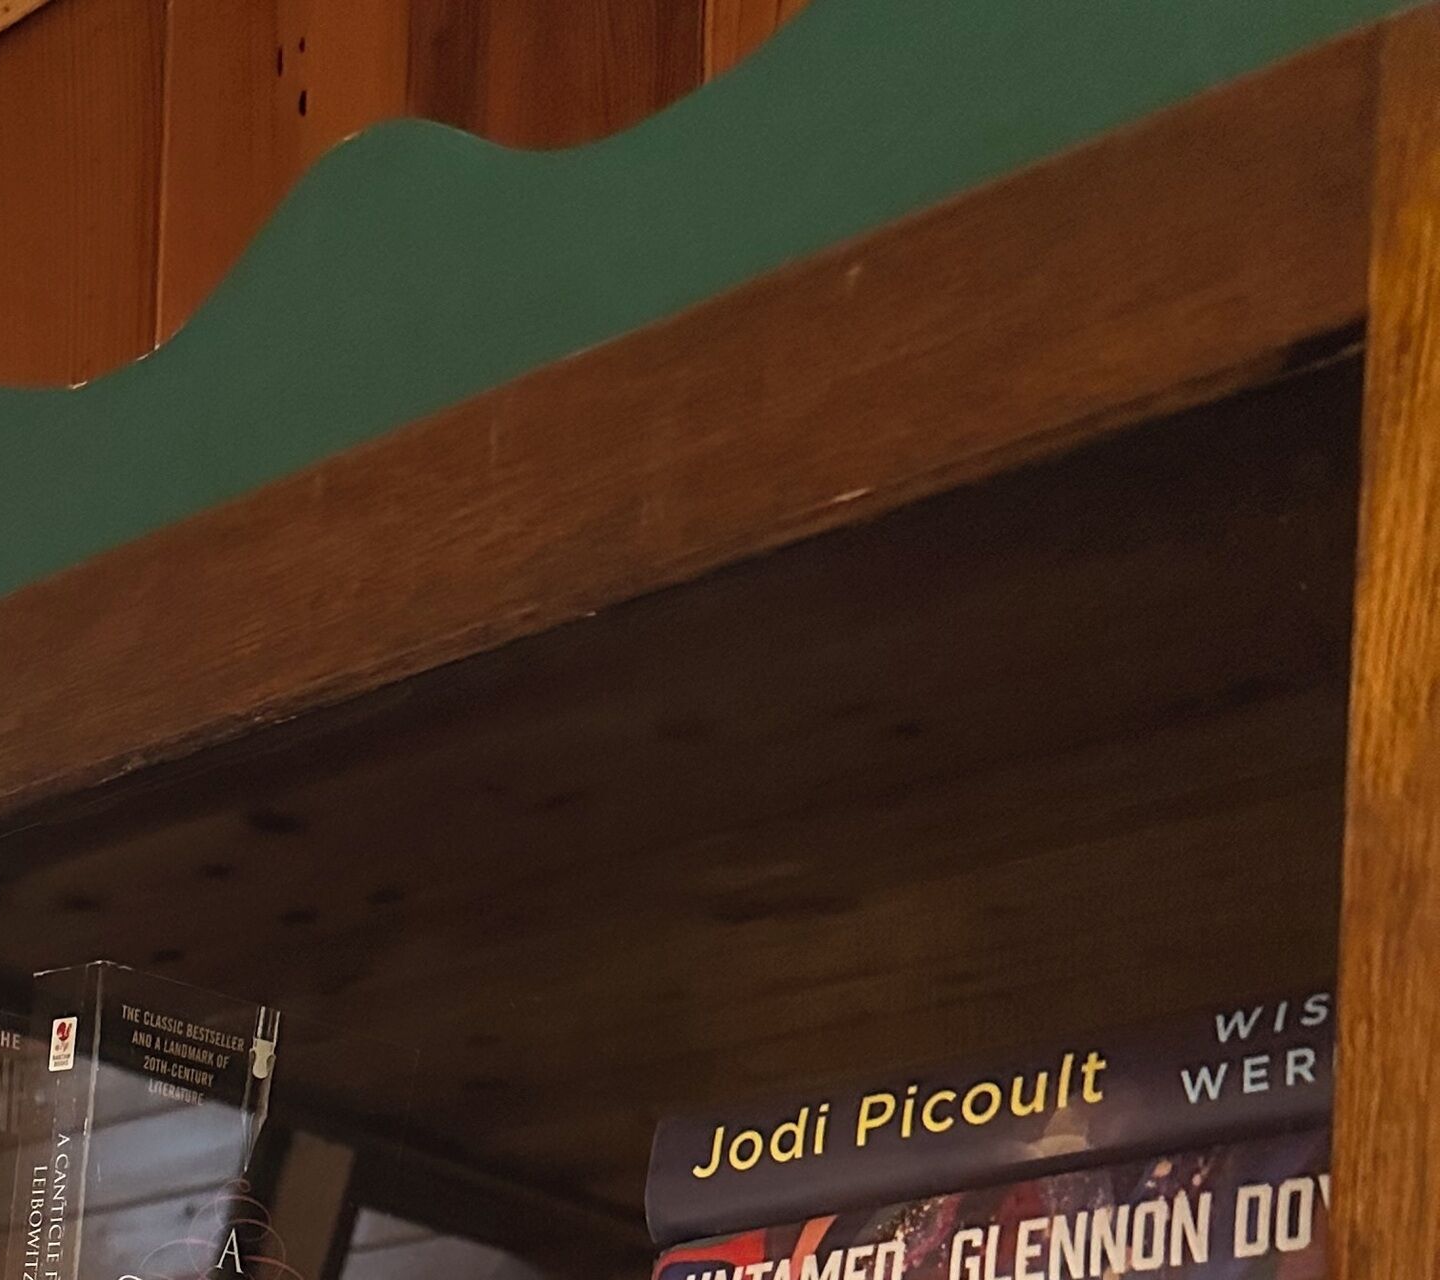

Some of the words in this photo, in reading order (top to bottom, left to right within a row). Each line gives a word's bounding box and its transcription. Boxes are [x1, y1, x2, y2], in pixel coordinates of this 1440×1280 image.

[122, 1005, 140, 1021] THE
[144, 1009, 184, 1036] CLASSIC
[186, 1023, 245, 1052] BESTSELLER
[132, 1030, 152, 1047] AND
[154, 1036, 162, 1049] A
[163, 1037, 214, 1066] LANDMARK
[217, 1055, 229, 1069] OF
[143, 1055, 214, 1088] 20TH-CENTURY
[148, 1079, 204, 1107] LITERATURE
[692, 1103, 830, 1179] Jodi
[856, 1052, 1107, 1147] Picoult
[58, 1134, 70, 1147] A
[46, 1153, 69, 1263] CANTICLE
[215, 1227, 244, 1274] A
